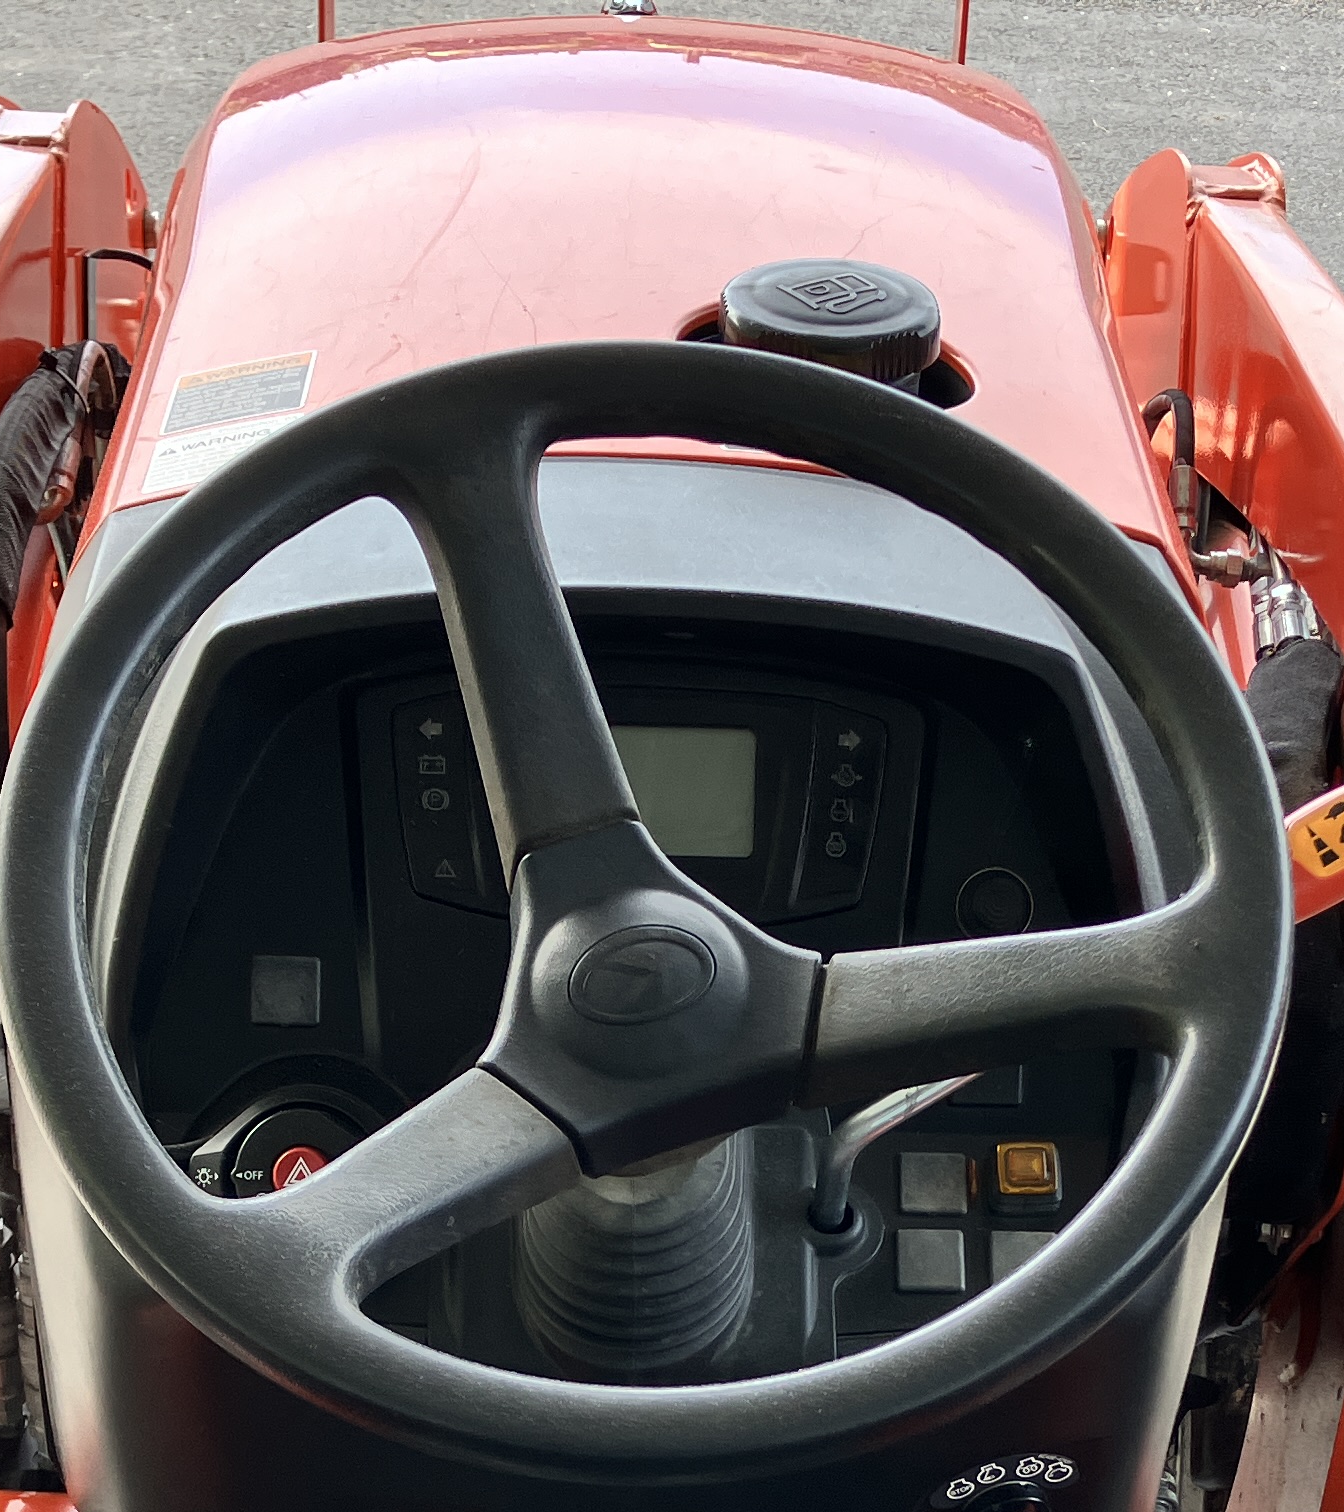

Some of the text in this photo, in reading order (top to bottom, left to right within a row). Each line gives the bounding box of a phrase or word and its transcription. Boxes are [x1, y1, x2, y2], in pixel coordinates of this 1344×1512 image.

[207, 359, 301, 379] WARNING
[182, 428, 271, 451] WARNING
[244, 1171, 263, 1180] OFF
